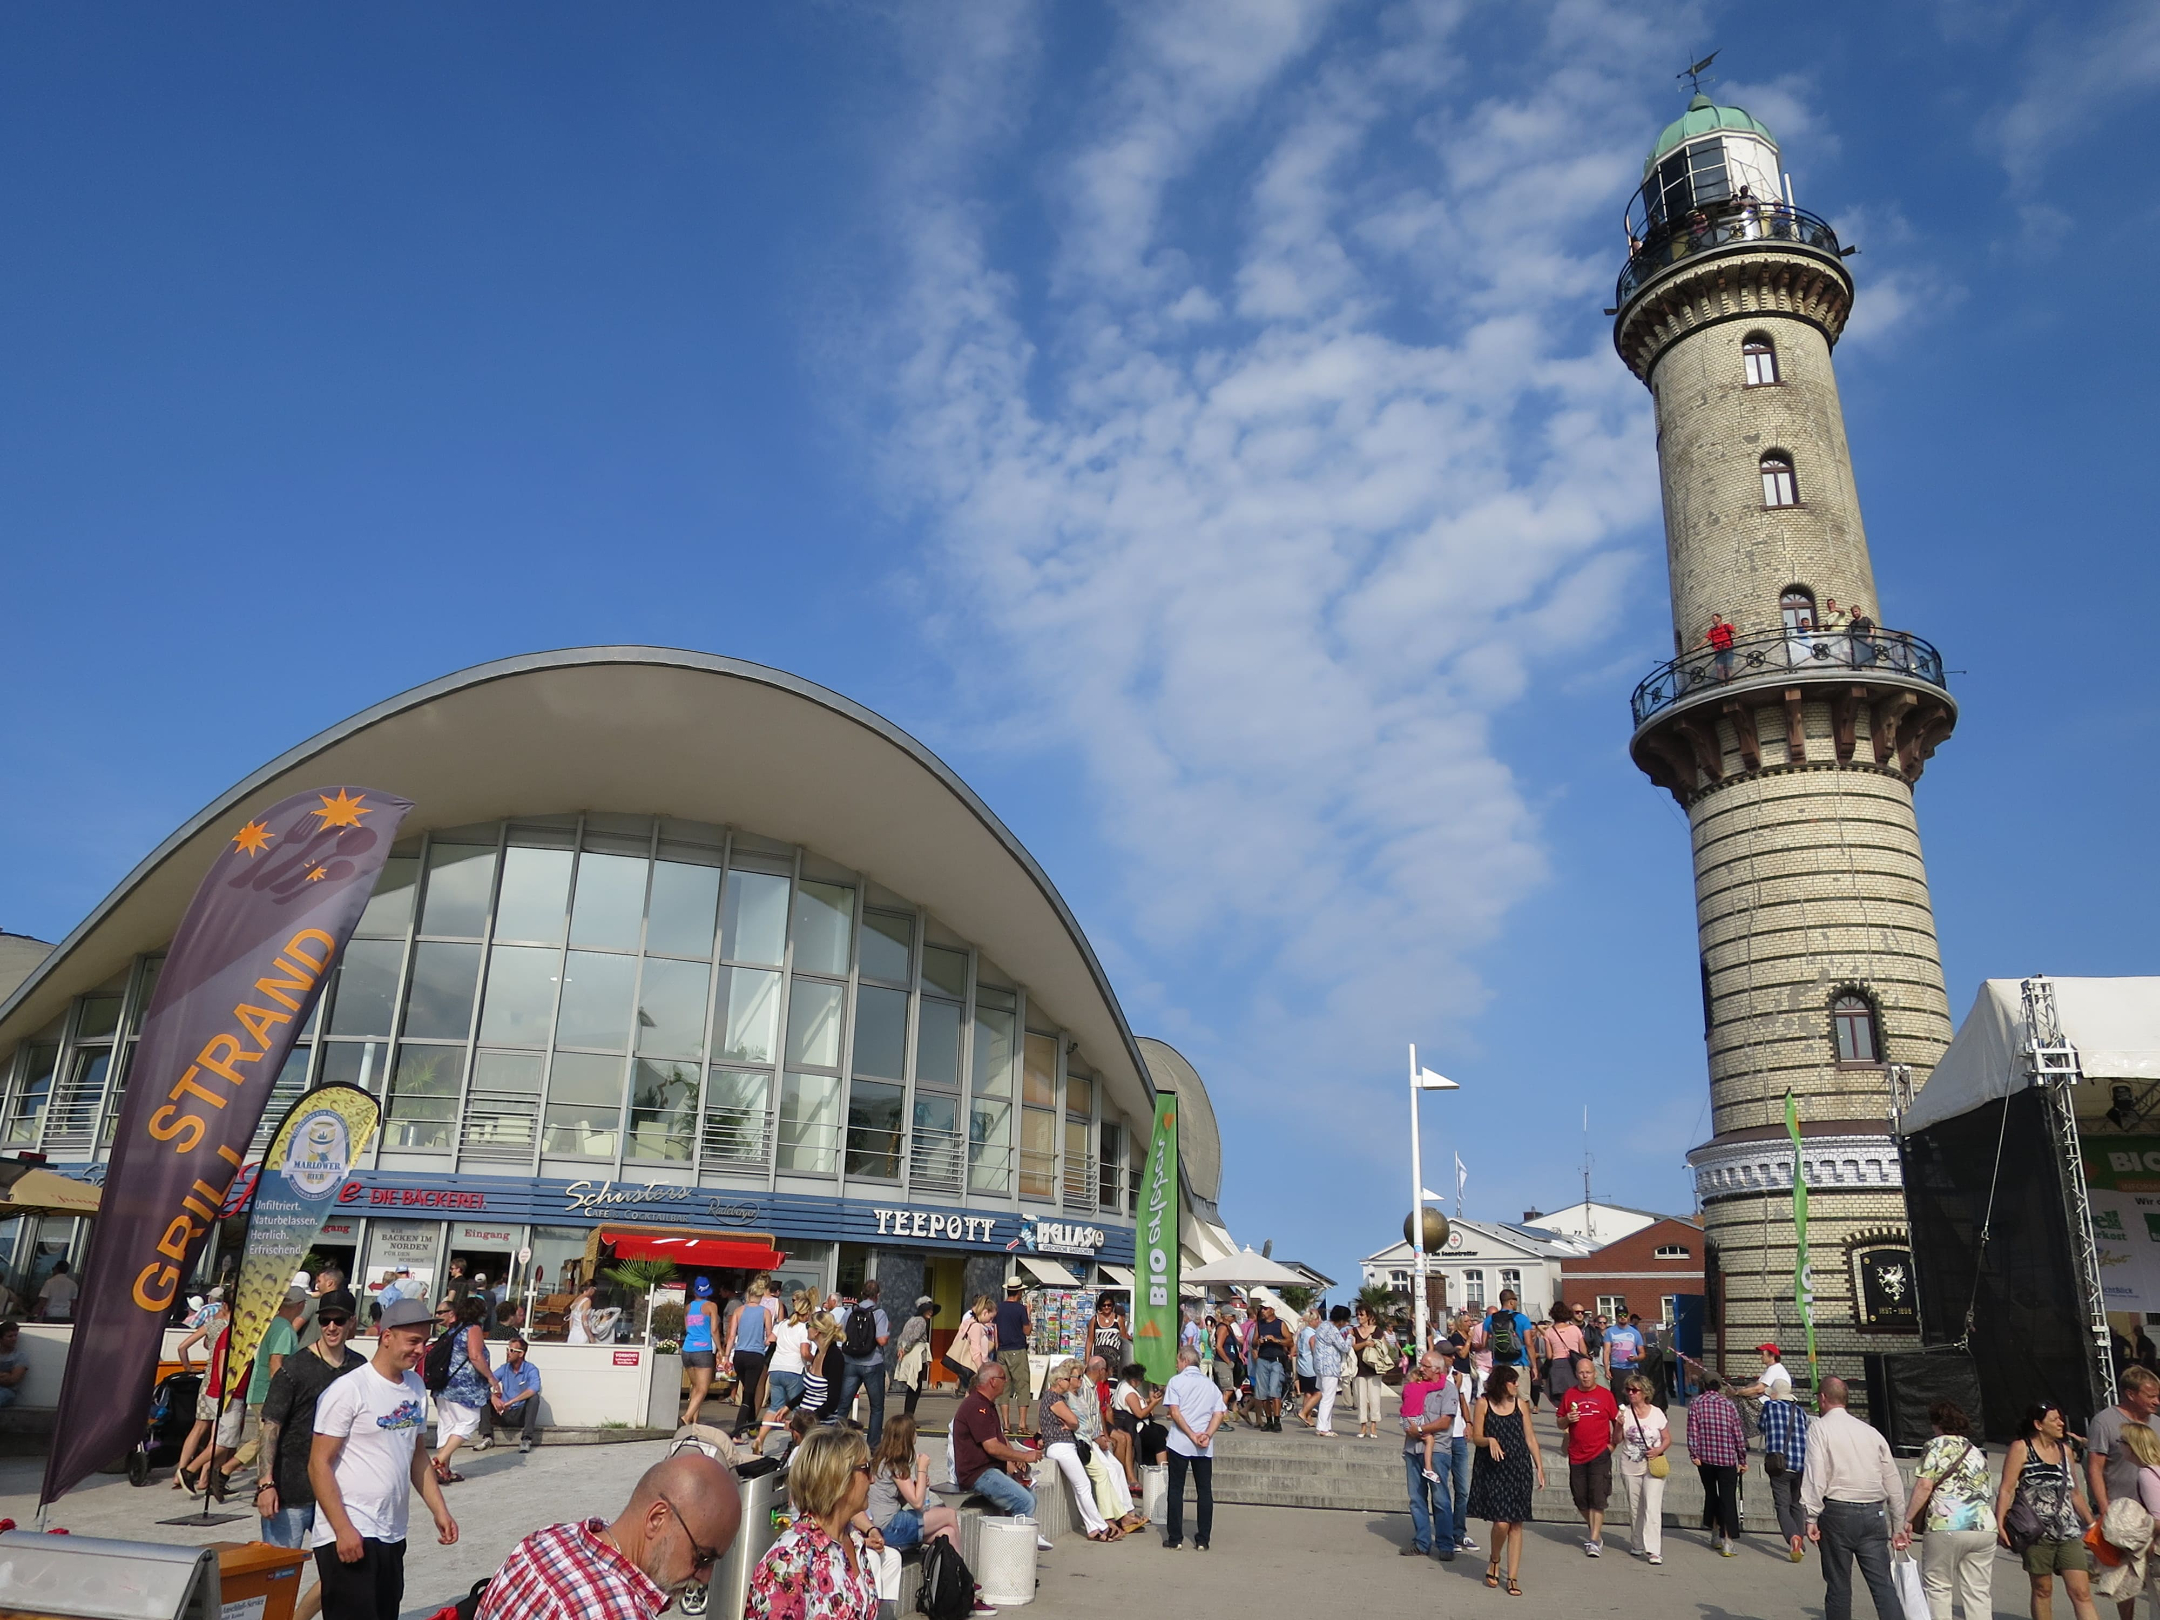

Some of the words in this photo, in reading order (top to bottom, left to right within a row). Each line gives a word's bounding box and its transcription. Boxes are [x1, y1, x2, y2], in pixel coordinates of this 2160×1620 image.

[148, 928, 337, 1153] STRAND
[294, 1160, 341, 1170] MARLOWER
[370, 1189, 398, 1205] DIE
[564, 1179, 693, 1211] Schusters
[2135, 1197, 2153, 1205] Wir
[254, 1200, 302, 1211] Unfiltriert.
[706, 1197, 758, 1223] Radeberger
[253, 1214, 318, 1225] Naturbelassen.
[873, 1209, 996, 1242] TEEPOTT
[250, 1229, 290, 1240] Herrlich.
[381, 1234, 419, 1242] BACKEN
[464, 1228, 511, 1241] Eingang
[1037, 1222, 1094, 1248] HELLAS
[249, 1244, 304, 1255] Erfrischend.
[390, 1242, 429, 1250] NORDEN
[1150, 1248, 1168, 1306] BIO
